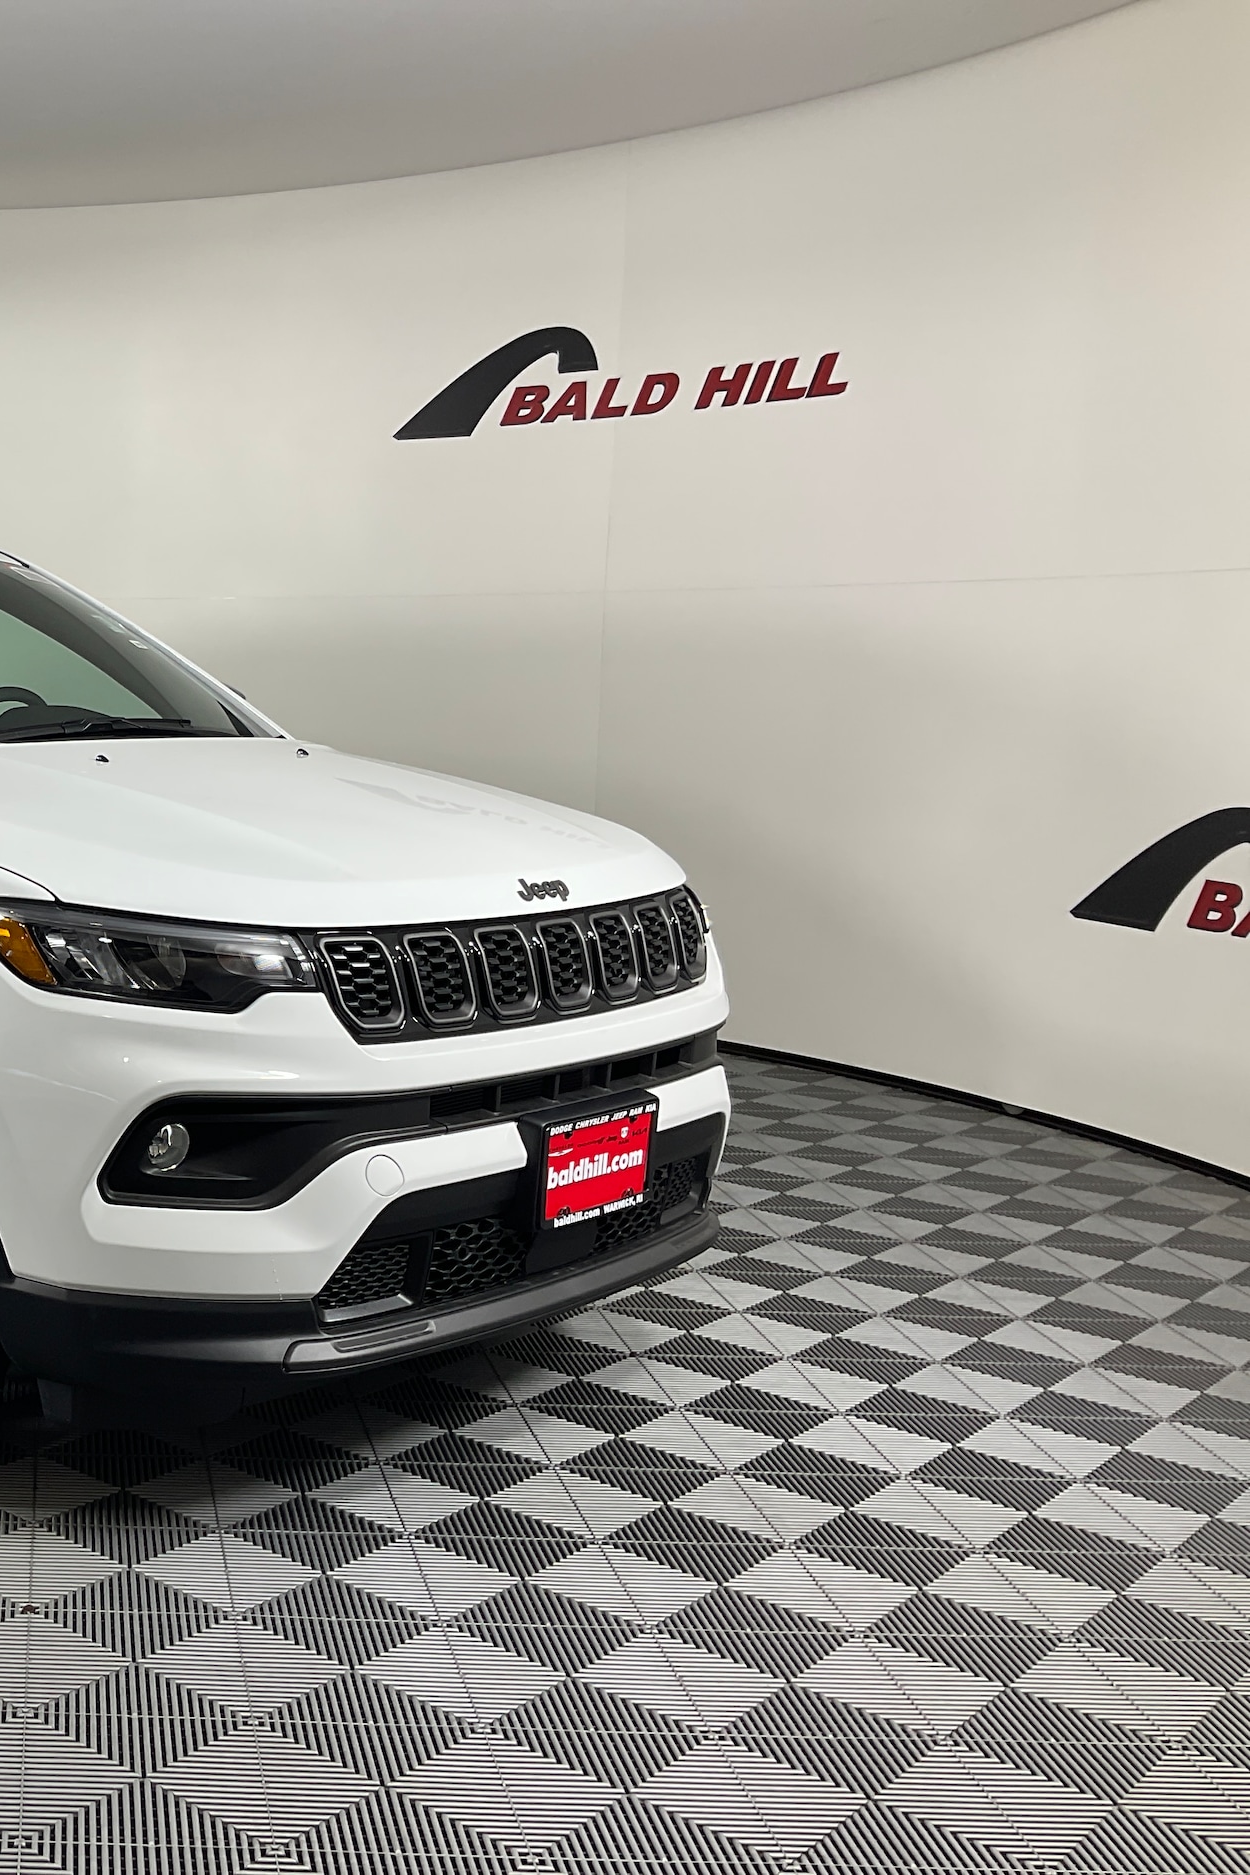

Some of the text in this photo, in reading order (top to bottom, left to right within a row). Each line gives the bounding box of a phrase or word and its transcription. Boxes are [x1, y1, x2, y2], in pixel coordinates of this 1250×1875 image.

[499, 351, 849, 427] BALD HILL
[516, 878, 571, 902] Jeep
[1186, 878, 1250, 938] B
[550, 1103, 656, 1136] DODGE CHRYSLER JEEP RAM KIA
[547, 1149, 643, 1190] baldhill.com
[553, 1207, 601, 1228] baldhill.com
